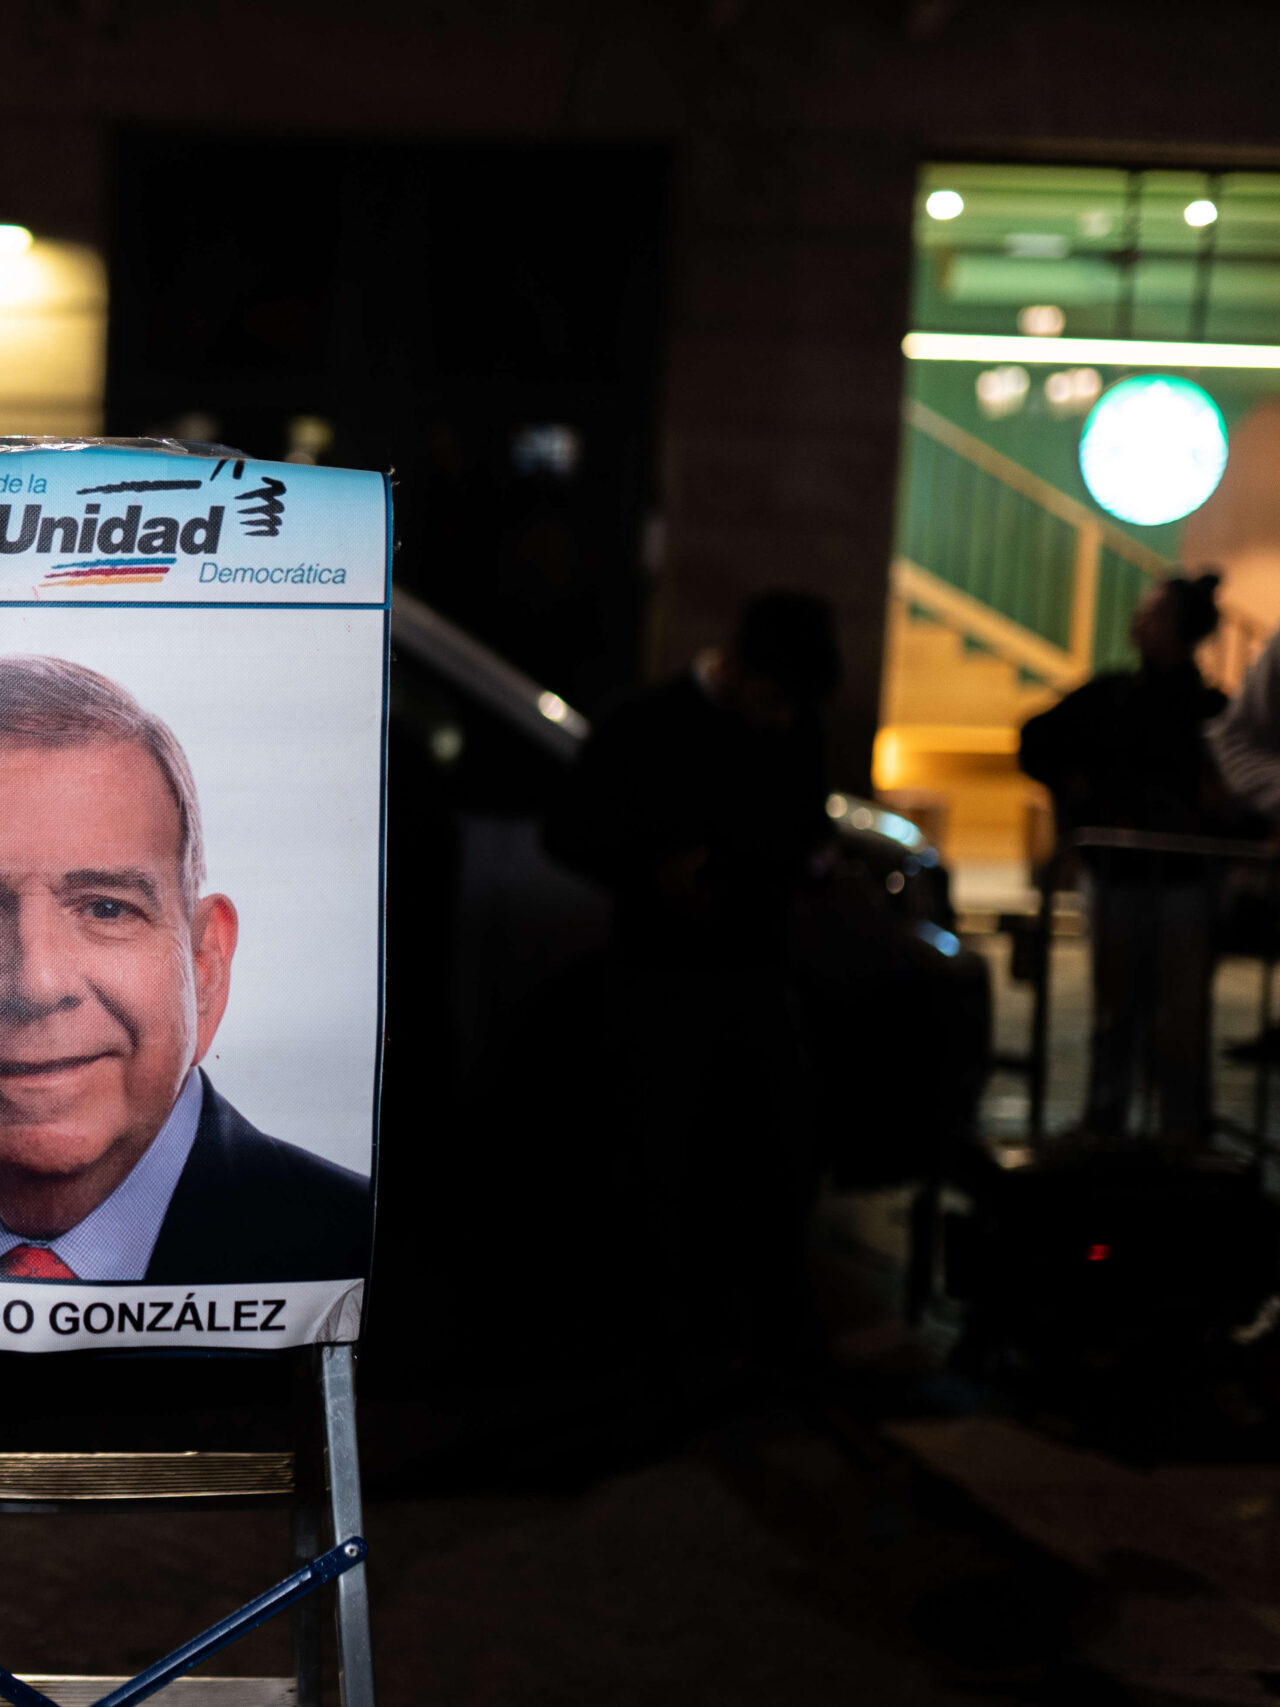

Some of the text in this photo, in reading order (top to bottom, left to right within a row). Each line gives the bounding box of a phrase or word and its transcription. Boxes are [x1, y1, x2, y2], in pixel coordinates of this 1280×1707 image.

[27, 473, 48, 494] la
[199, 562, 347, 584] Democrática
[48, 1292, 287, 1336] GONZÁLEZ
